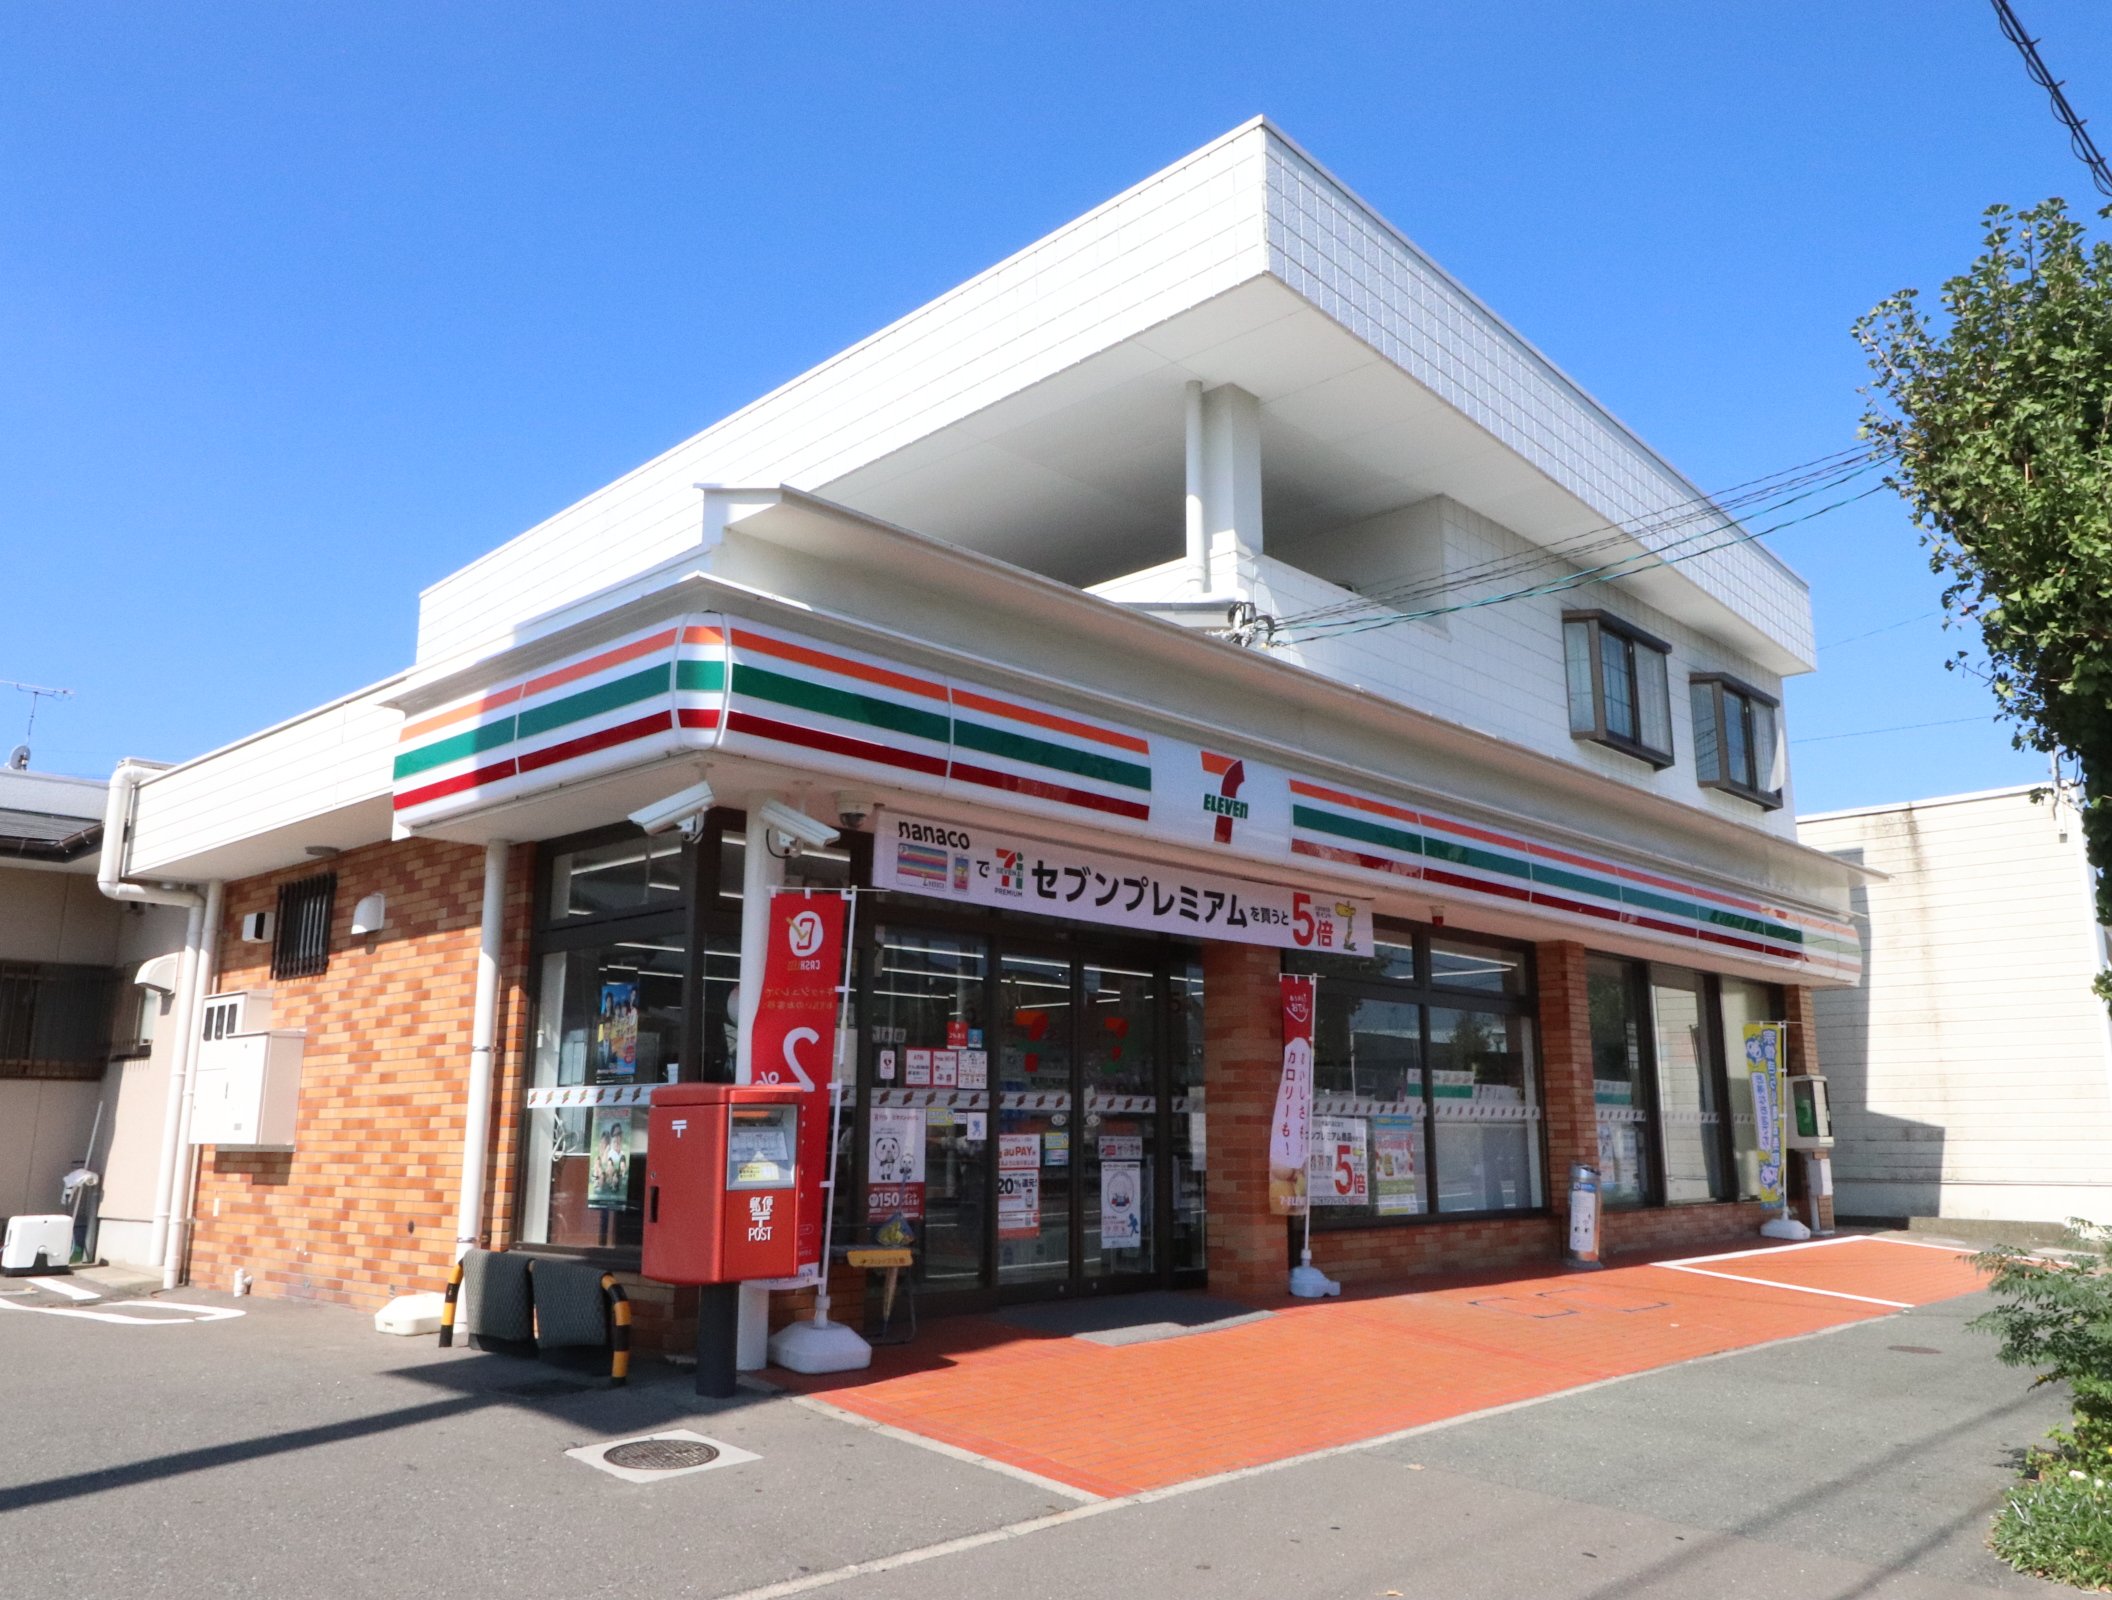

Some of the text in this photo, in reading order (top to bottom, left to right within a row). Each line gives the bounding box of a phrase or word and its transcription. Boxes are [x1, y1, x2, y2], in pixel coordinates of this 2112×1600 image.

[1201, 751, 1245, 844] 7
[898, 821, 971, 850] nanaco
[976, 860, 991, 879] で
[994, 887, 1024, 898] PREMIUM
[749, 1196, 774, 1213] 郵便
[879, 1192, 900, 1207] 150
[747, 1226, 774, 1242] POST
